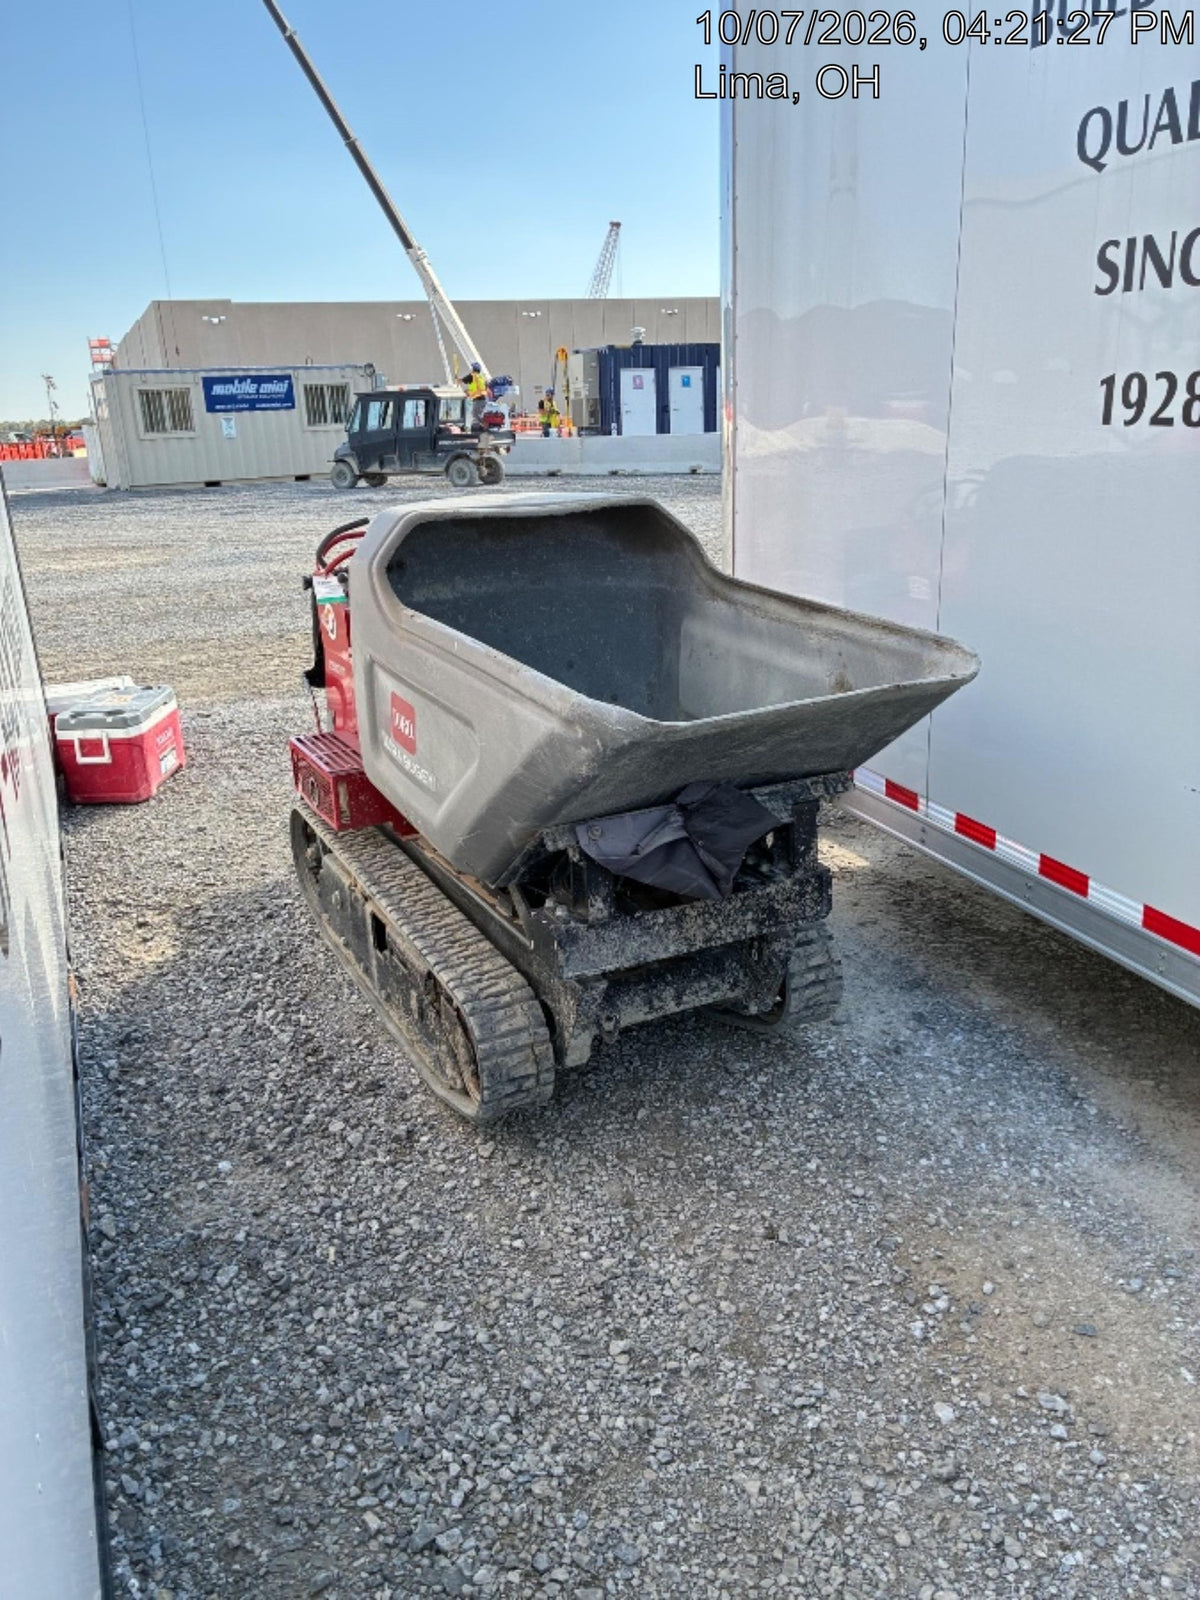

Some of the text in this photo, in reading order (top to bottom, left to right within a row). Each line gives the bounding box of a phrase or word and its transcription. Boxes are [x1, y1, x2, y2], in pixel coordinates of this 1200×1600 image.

[211, 378, 290, 395] mobile mini
[1100, 370, 1200, 427] 1928
